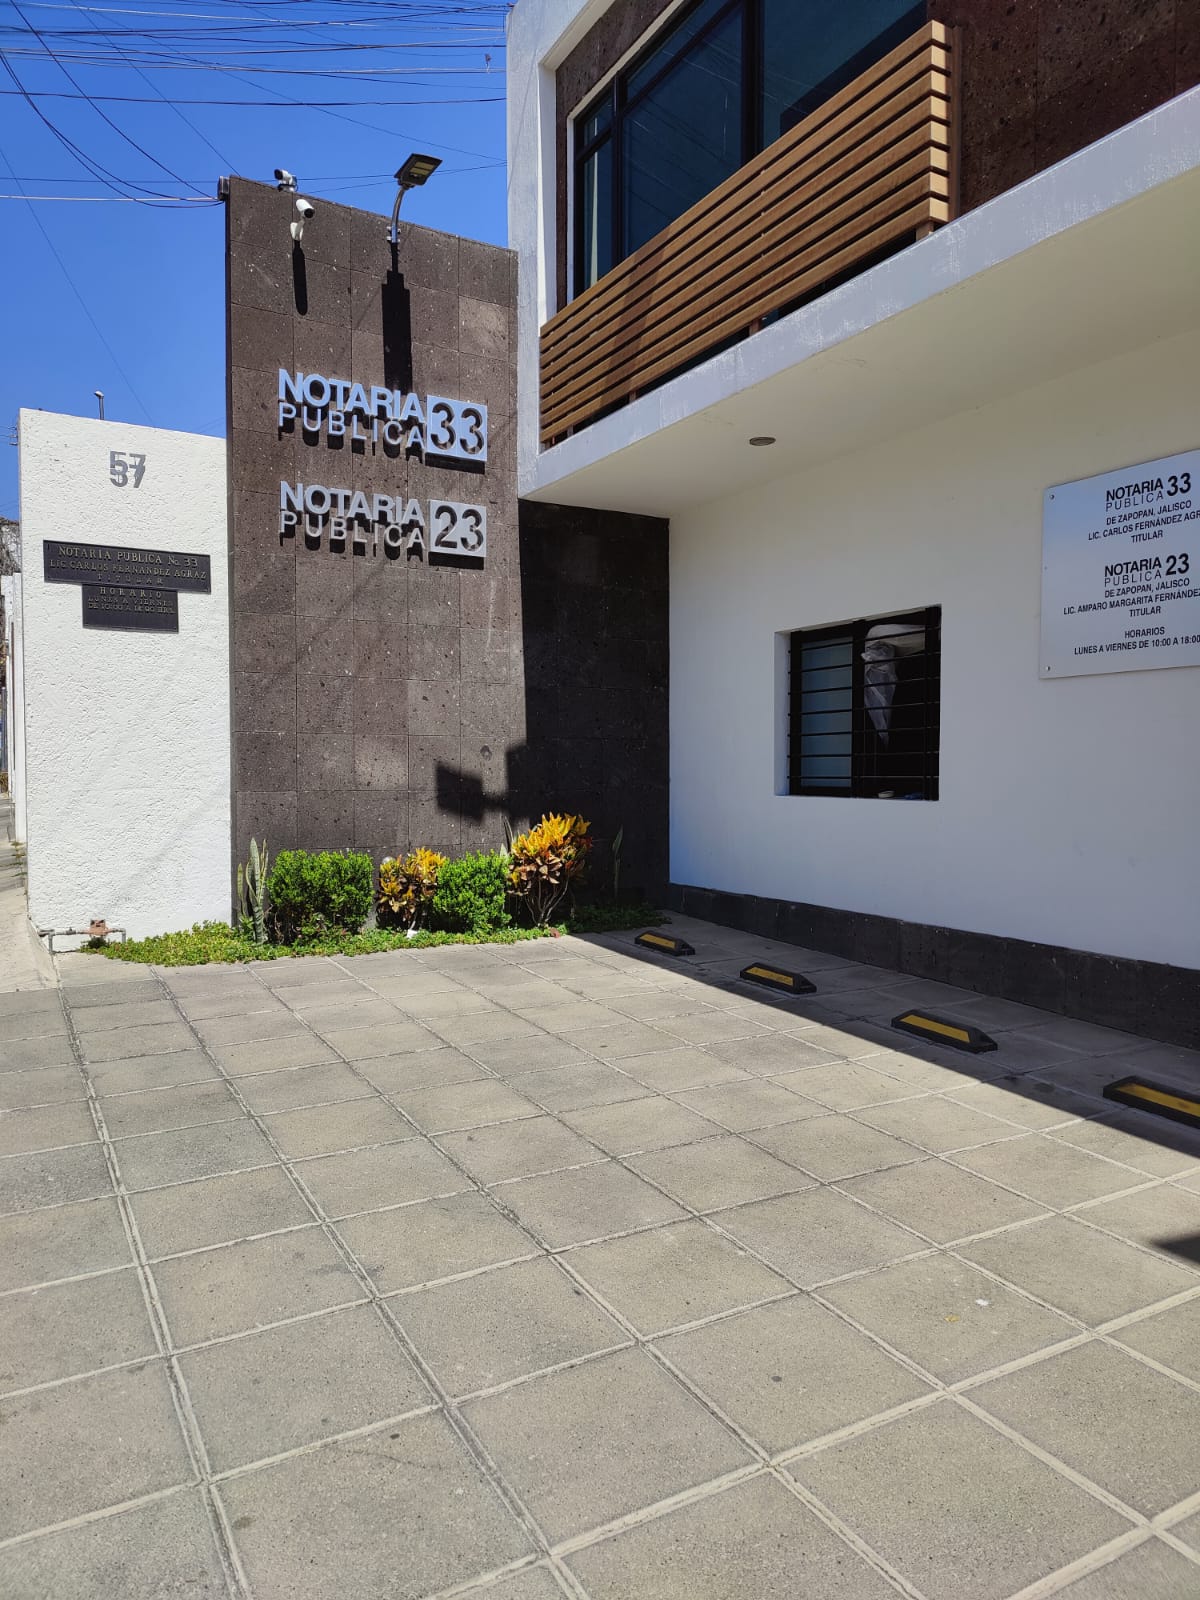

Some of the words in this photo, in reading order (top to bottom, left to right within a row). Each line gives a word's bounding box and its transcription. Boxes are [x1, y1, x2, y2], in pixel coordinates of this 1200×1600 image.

[279, 368, 424, 423] NOTARIA
[430, 402, 484, 455] 33
[279, 402, 424, 449] PUBLICA
[110, 451, 146, 478] 57
[1106, 478, 1164, 502] NOTARIA
[1166, 472, 1192, 496] 33
[1106, 490, 1164, 512] PUBLICA
[280, 481, 425, 526] NOTARIA
[435, 505, 484, 551] 23
[1106, 516, 1117, 526] DE
[1118, 508, 1155, 524] ZAPOPAN,
[1158, 500, 1192, 515] JALISCO
[280, 510, 425, 549] PUBLICA
[1088, 530, 1101, 541] LIC.
[1103, 524, 1133, 538] CARLOS
[1135, 514, 1182, 532] FERNÁNDEZ
[1131, 530, 1164, 543] TITULAR
[58, 546, 111, 560] NOTARIA
[117, 552, 162, 564] PUBLICA
[184, 558, 198, 566] 33
[1104, 557, 1162, 577] NOTARIA
[1165, 553, 1189, 576] 23
[70, 561, 108, 570] CARLOS
[174, 570, 207, 579] AGRAZ
[1104, 570, 1162, 587] PUBLICA
[100, 587, 162, 598] HORARIO
[1105, 590, 1115, 598] DE
[1116, 584, 1154, 597] ZAPOPAN,
[1156, 578, 1190, 592] JALISCO
[1063, 606, 1076, 615] LIC.
[1077, 602, 1108, 614] AMPARO
[1110, 595, 1153, 609] MARGARITA
[1129, 606, 1161, 617] TITULAR
[1124, 627, 1165, 639] HORARIOS
[1074, 644, 1098, 655] LUNES
[1098, 643, 1104, 652] A
[1105, 639, 1137, 652] VIERNES
[1139, 639, 1150, 649] DE
[1152, 638, 1171, 647] 10:00
[1173, 637, 1179, 645] A
[1181, 635, 1200, 645] 18:00
